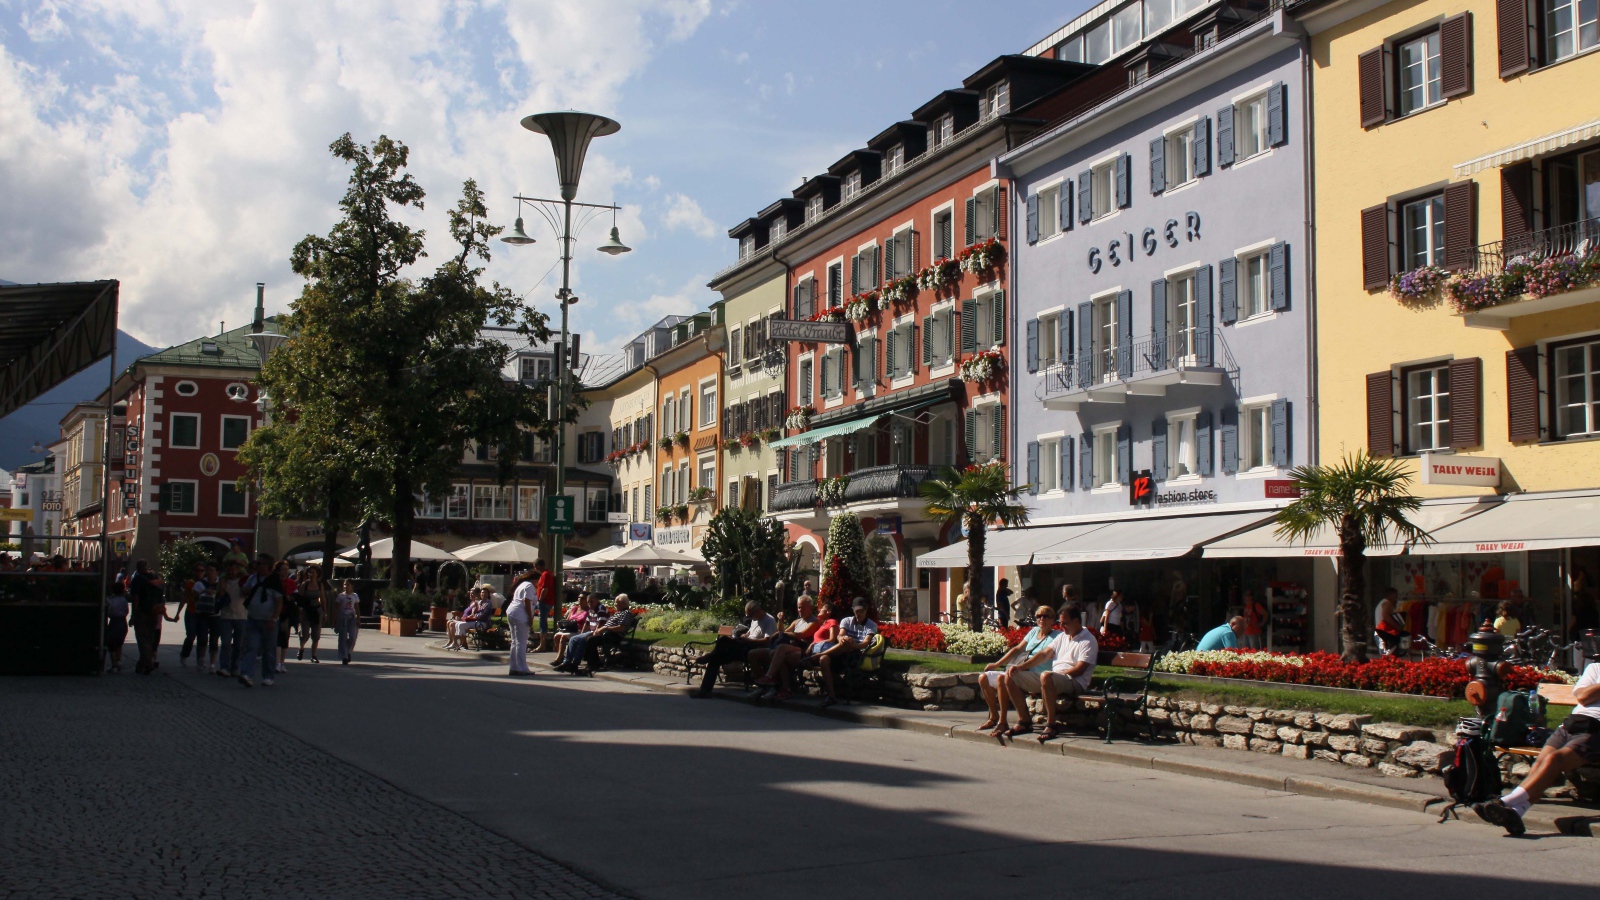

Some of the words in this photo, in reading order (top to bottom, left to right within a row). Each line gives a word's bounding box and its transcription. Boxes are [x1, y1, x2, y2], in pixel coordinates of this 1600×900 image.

[1087, 210, 1201, 274] GEIGER
[772, 321, 805, 337] Hotel
[804, 324, 845, 339] Traube
[125, 426, 137, 507] SCHUHE
[1432, 464, 1462, 475] TALLY
[1134, 477, 1150, 500] 12
[1154, 490, 1187, 504] fashion
[1188, 488, 1213, 501] store
[1268, 485, 1291, 494] name
[42, 502, 62, 511] FOTO
[1475, 543, 1499, 551] TALLY
